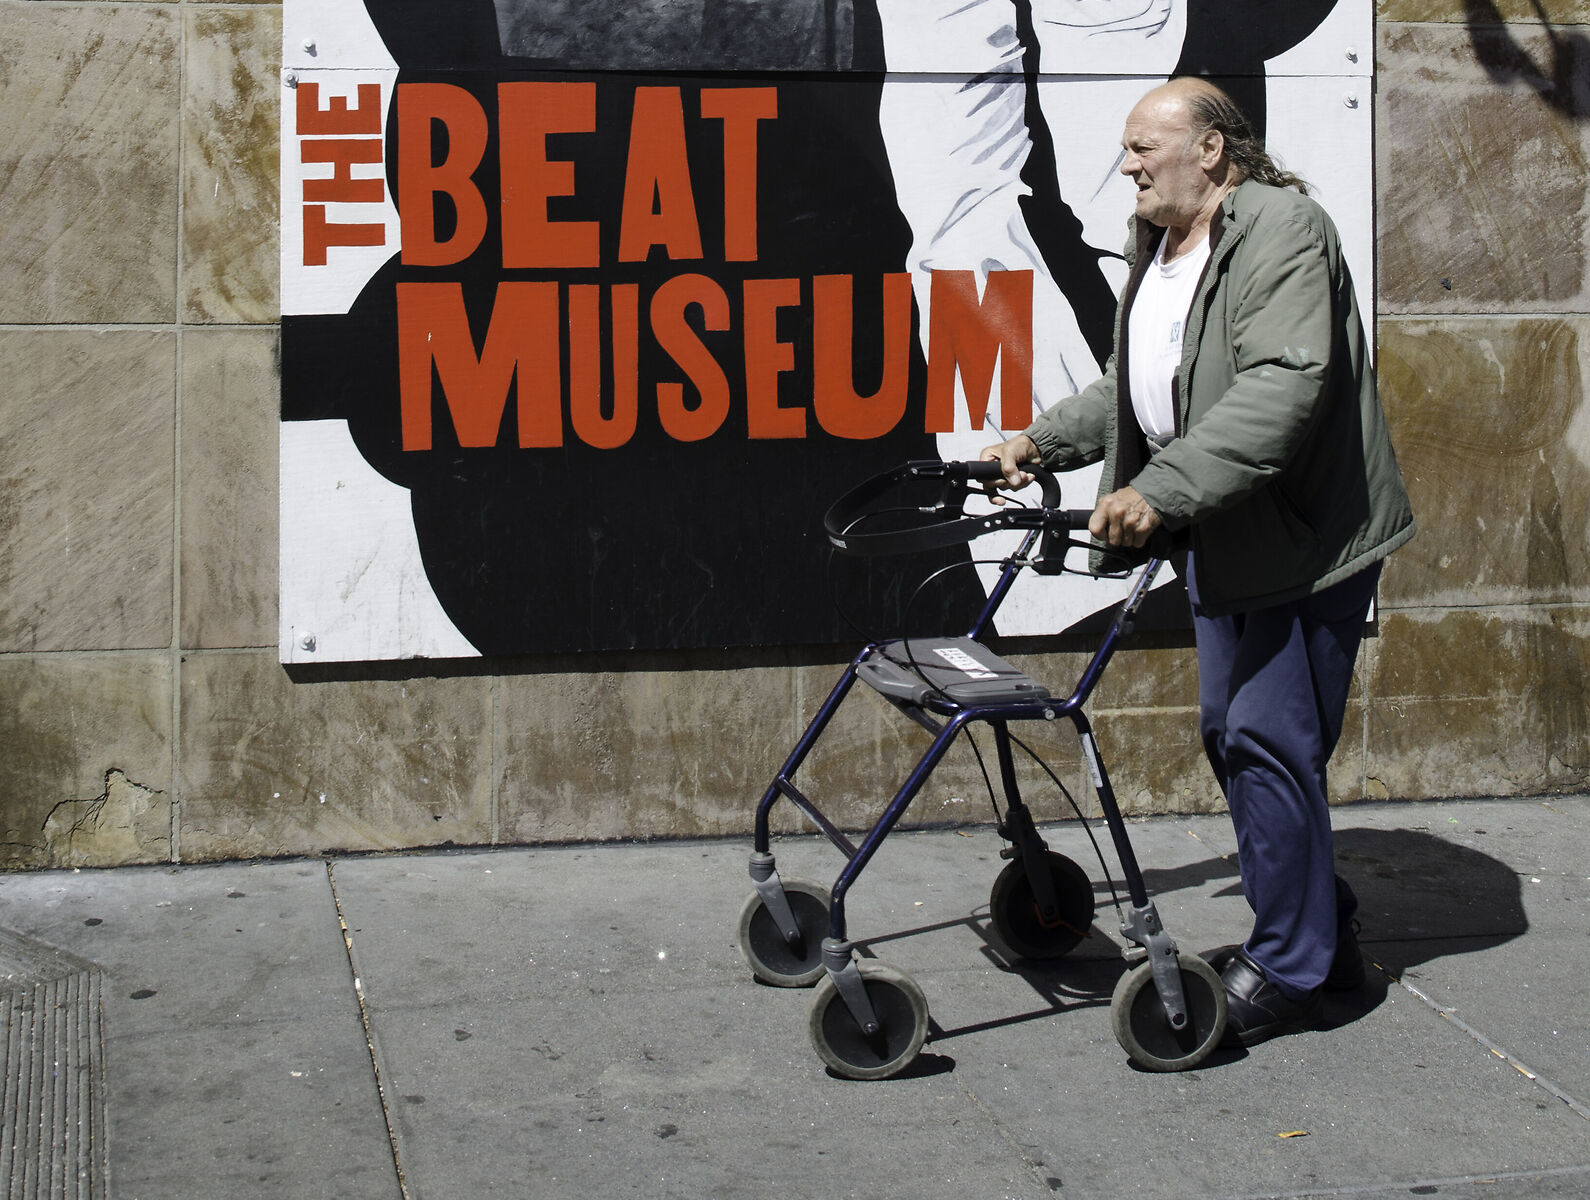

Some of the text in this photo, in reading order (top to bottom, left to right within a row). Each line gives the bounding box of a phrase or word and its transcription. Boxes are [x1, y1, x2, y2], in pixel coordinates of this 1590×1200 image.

[296, 82, 386, 267] THE
[397, 81, 778, 269] BEAT
[396, 269, 1034, 452] MUSEUM
